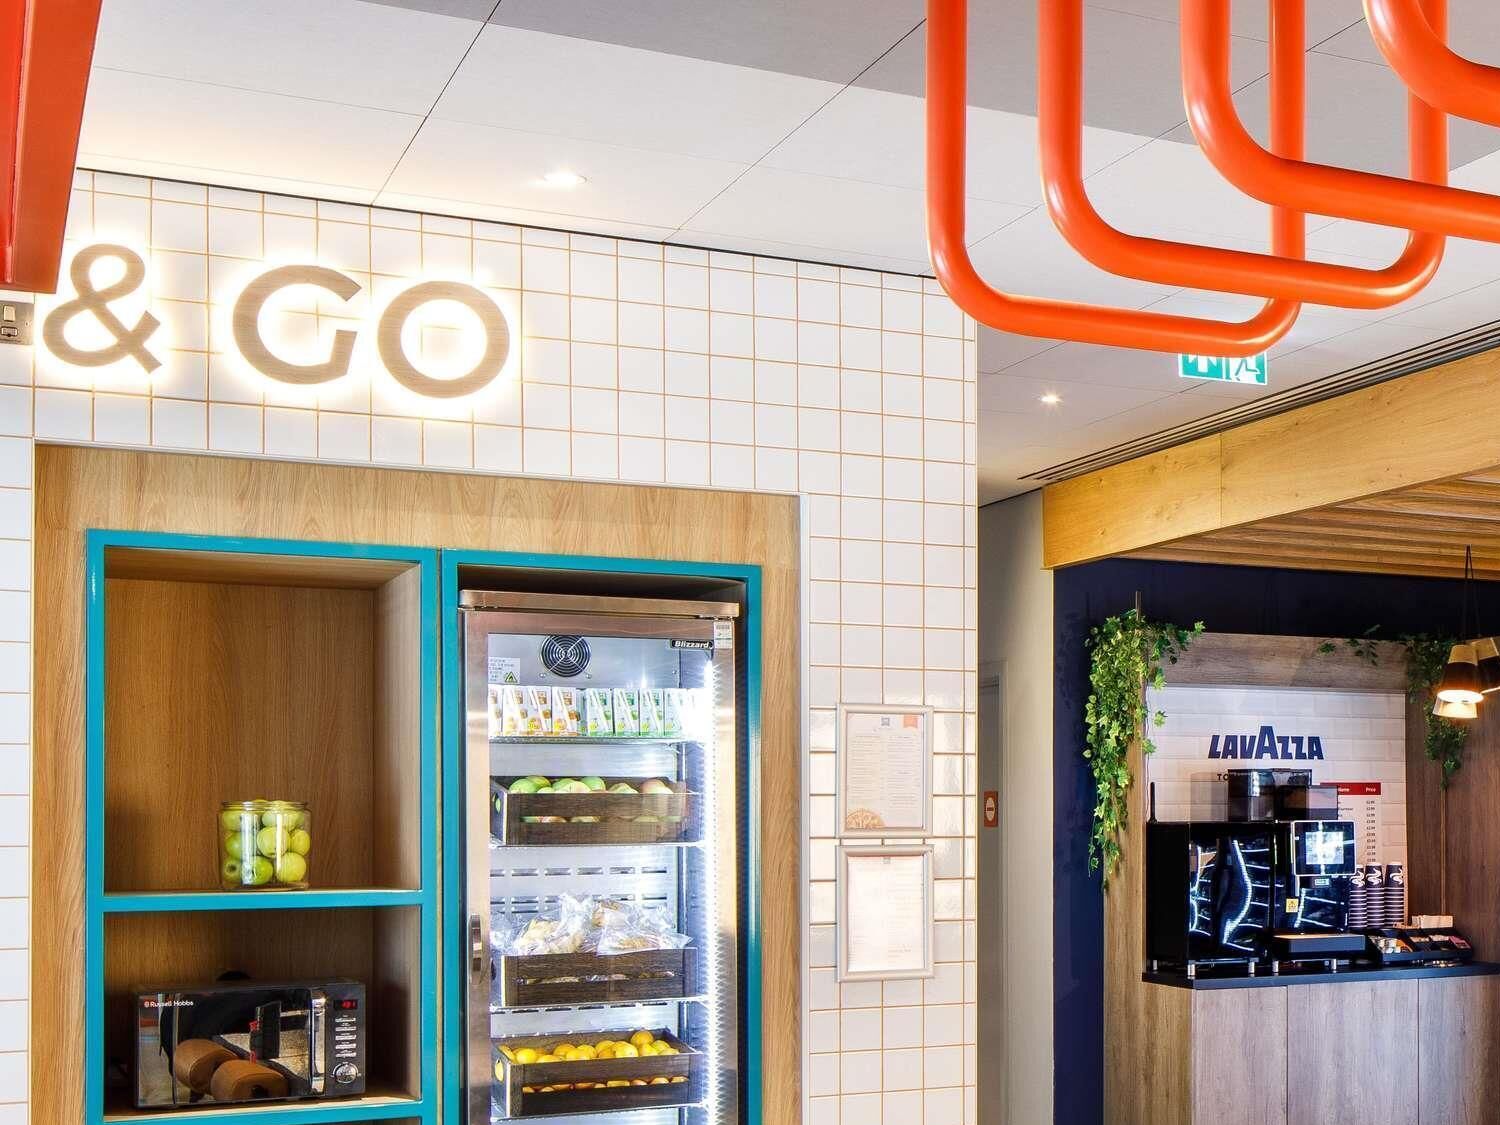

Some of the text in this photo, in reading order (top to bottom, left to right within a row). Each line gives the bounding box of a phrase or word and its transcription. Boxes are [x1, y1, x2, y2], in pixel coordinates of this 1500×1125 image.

[42, 243, 511, 400] & GO
[674, 640, 710, 649] Blizzard
[1207, 725, 1325, 759] LAVAZZA
